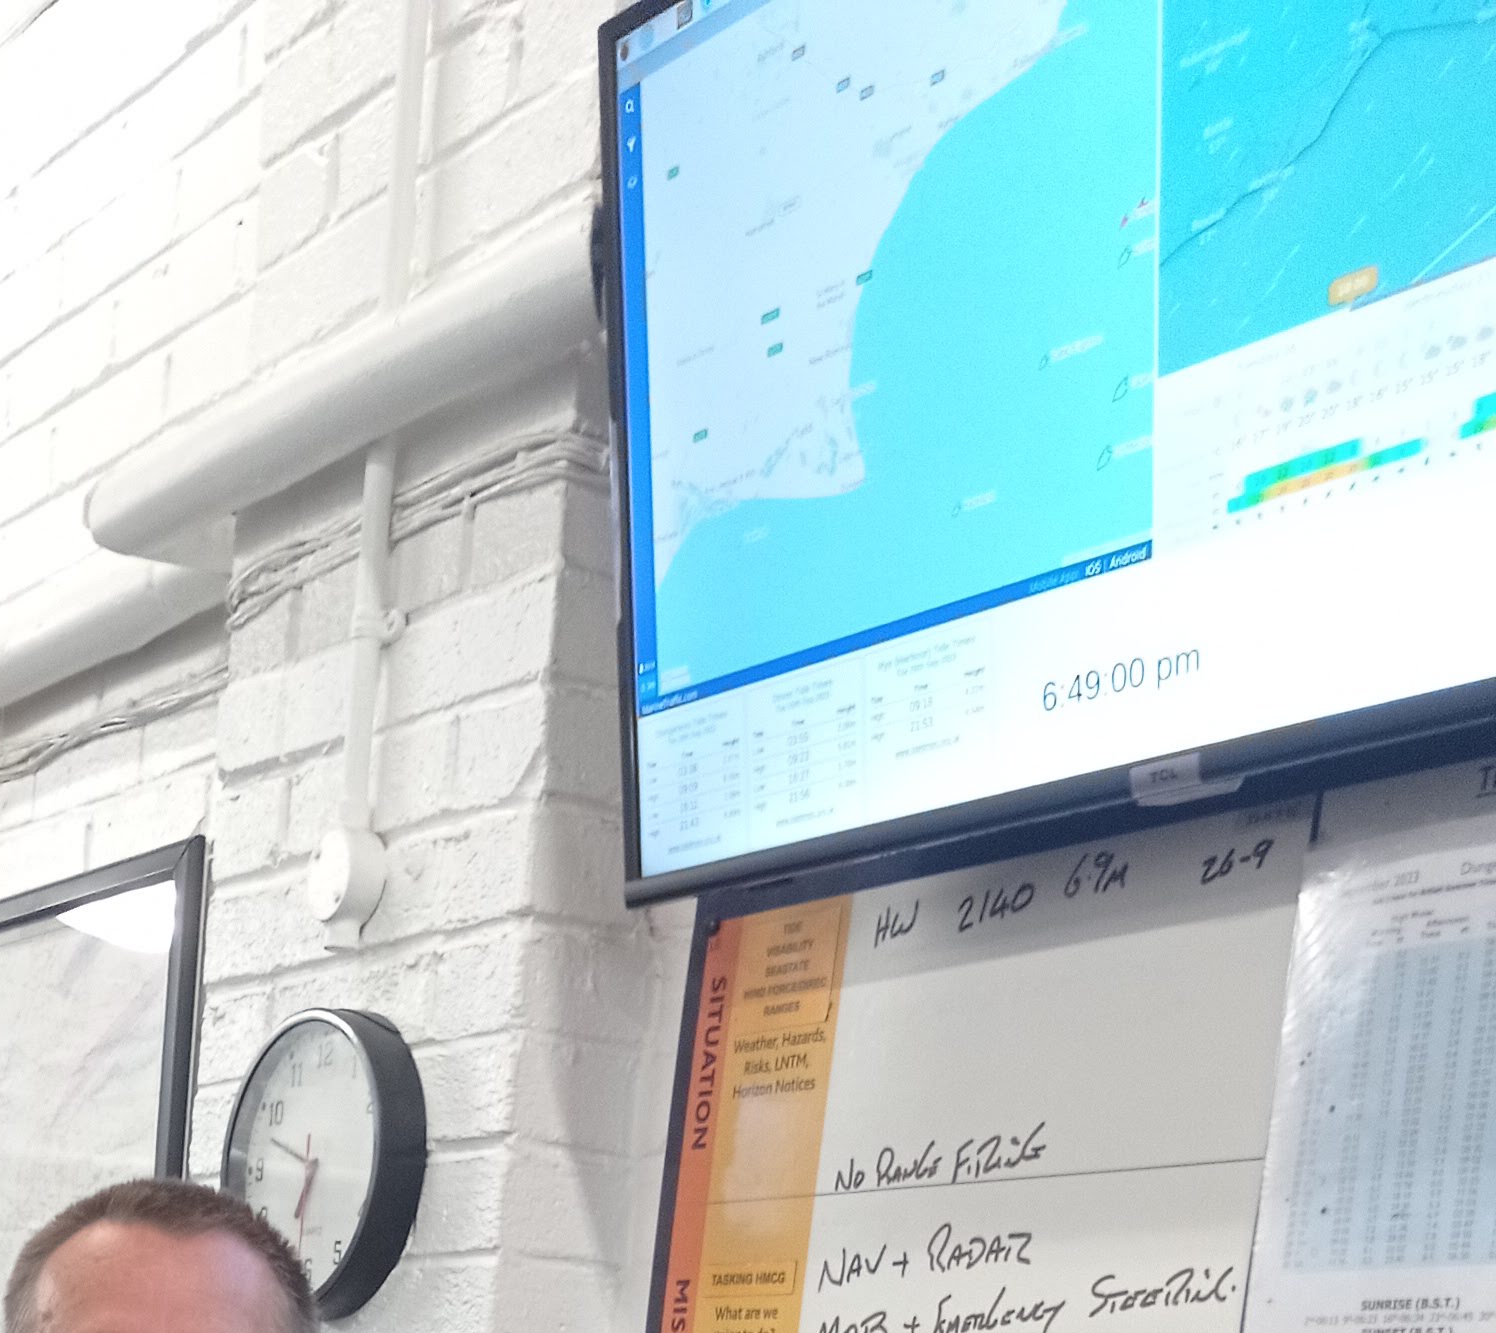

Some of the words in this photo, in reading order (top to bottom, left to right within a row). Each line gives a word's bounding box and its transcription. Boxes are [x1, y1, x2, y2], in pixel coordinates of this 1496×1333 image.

[1108, 546, 1147, 570] Android
[1042, 657, 1146, 712] 6:49:00
[1156, 649, 1200, 689] pm
[874, 901, 918, 948] HW
[958, 883, 1035, 933] 2140
[734, 1037, 779, 1055] Weather,
[781, 1028, 826, 1049] Hazards,
[290, 1062, 303, 1088] 11
[693, 976, 728, 1151] SITUATION
[744, 1060, 772, 1076] Risks,
[774, 1054, 809, 1072] LNTM,
[733, 1083, 774, 1099] Horizon
[775, 1076, 816, 1095] Notices
[269, 1101, 284, 1126] 10
[255, 1158, 264, 1183] 9
[333, 1240, 343, 1265] 5
[817, 1244, 887, 1292] NAV
[928, 1222, 1033, 1273] RADAR
[712, 1274, 753, 1287] TASKING
[715, 1307, 743, 1322] What
[745, 1309, 761, 1320] are
[763, 1308, 779, 1320] we
[1361, 1299, 1413, 1311] SUNRISE
